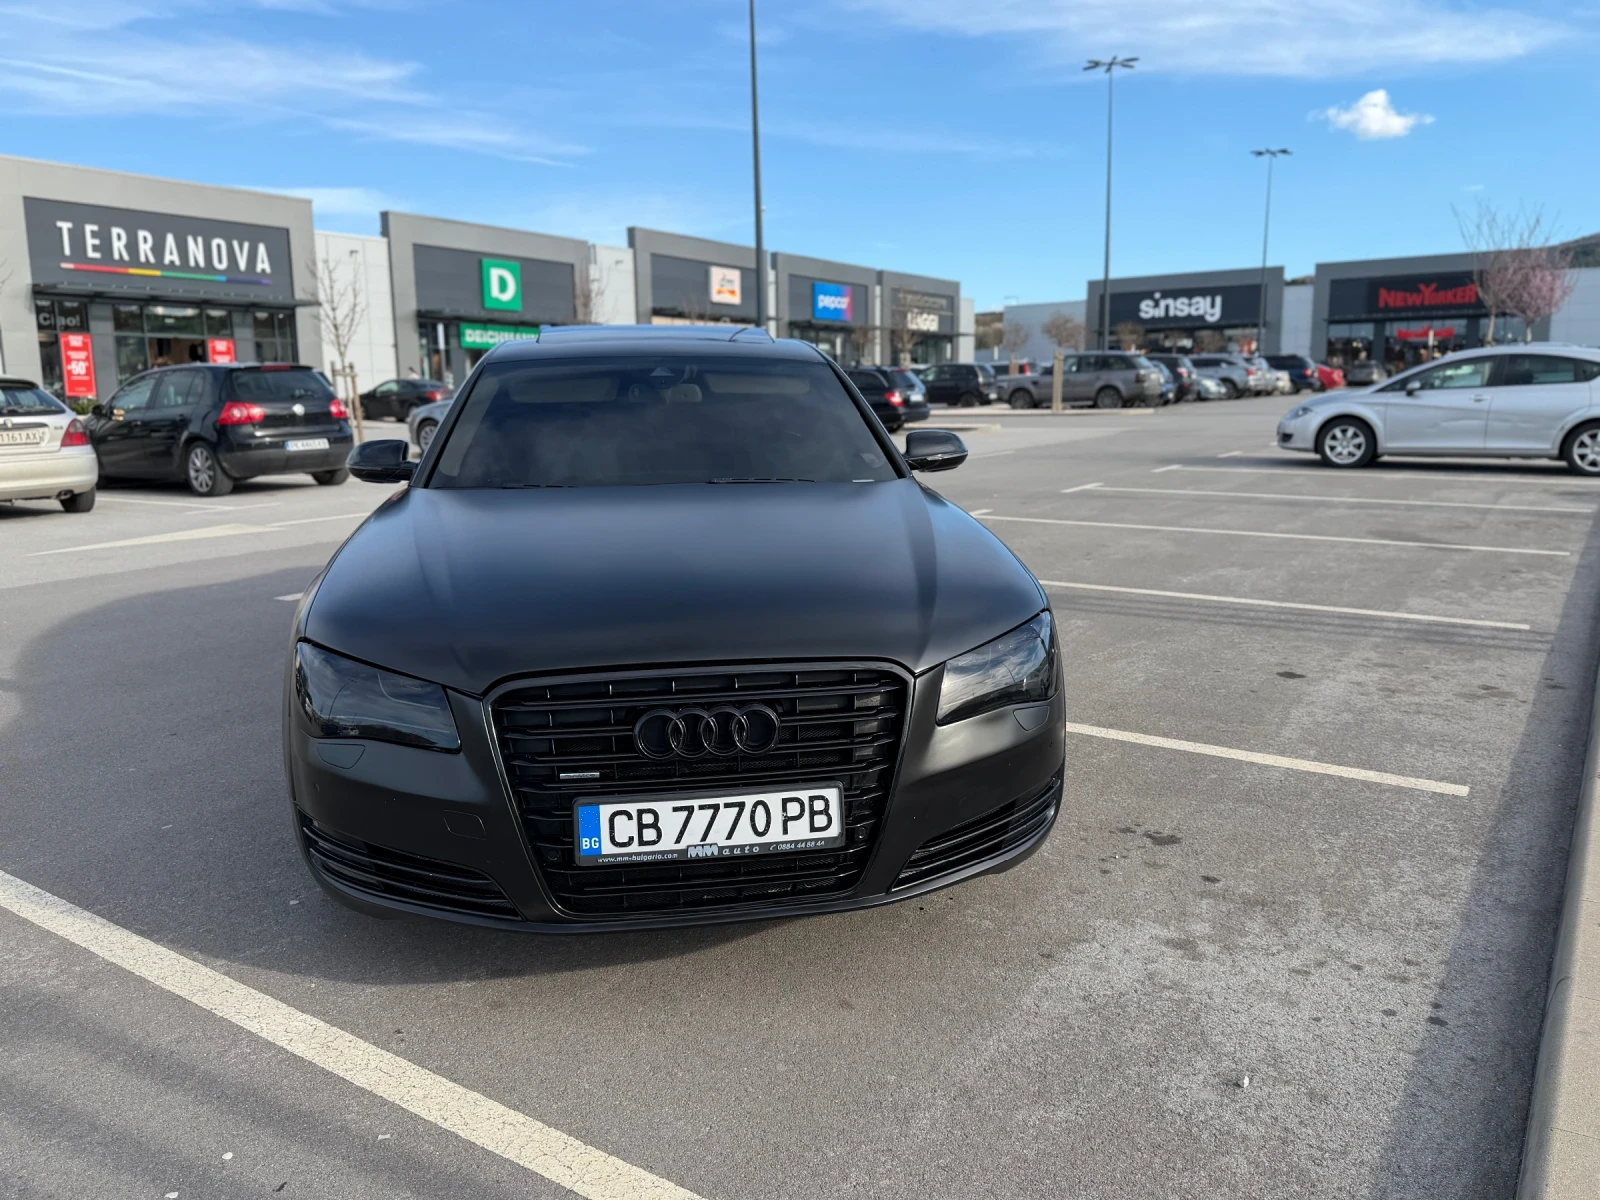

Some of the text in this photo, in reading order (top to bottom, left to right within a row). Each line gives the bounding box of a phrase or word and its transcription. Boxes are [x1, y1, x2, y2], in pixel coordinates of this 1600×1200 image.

[56, 220, 272, 274] TERRANOVA
[489, 267, 517, 302] D
[1138, 291, 1222, 323] sinsay
[608, 794, 833, 848] CB 7770 PB
[582, 837, 600, 850] BG
[722, 845, 760, 856] auto
